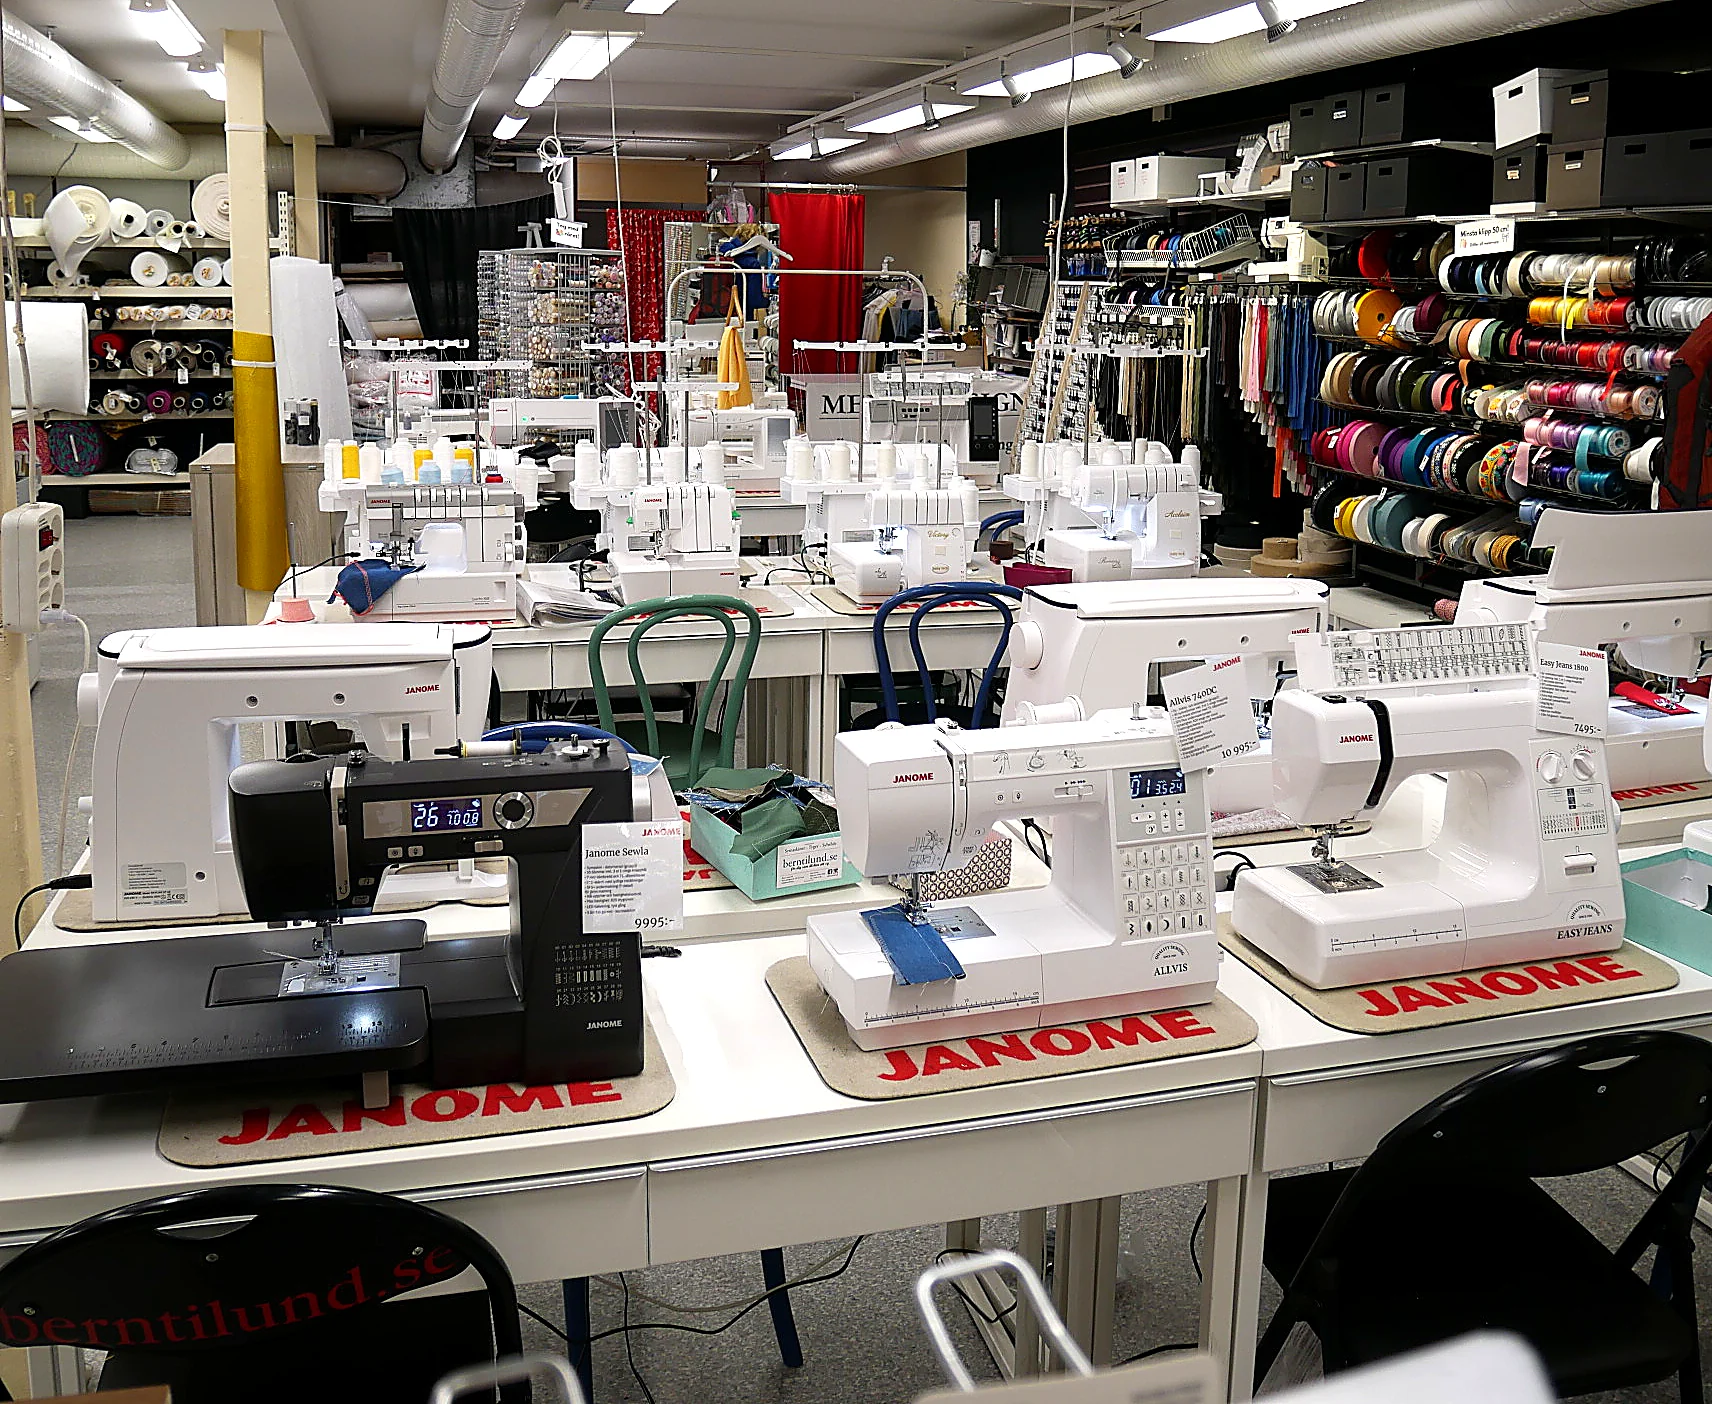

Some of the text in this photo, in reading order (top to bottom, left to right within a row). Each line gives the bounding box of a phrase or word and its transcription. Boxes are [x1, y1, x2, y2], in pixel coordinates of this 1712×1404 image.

[1579, 650, 1606, 660] JANOME
[1212, 655, 1242, 672] JANOME
[1540, 658, 1589, 672] Easy Jeans 1800
[405, 684, 440, 695] JANOME
[1169, 685, 1218, 708] Allvis 740DC
[1339, 734, 1374, 744] JANOME
[1221, 748, 1232, 759] 10
[892, 772, 934, 784] JANOME
[413, 805, 439, 828] 26
[585, 846, 649, 859] Janome Sewla
[782, 852, 838, 869] berntilund.se
[1557, 923, 1613, 940] EASY JEANS
[1154, 962, 1188, 977] ALLVIS
[1357, 956, 1643, 1017] JANOME
[586, 1019, 623, 1030] JANOME
[877, 1009, 1216, 1082] JANOME
[216, 1080, 622, 1146] JANOME
[0, 1243, 459, 1347] berntilund.se
